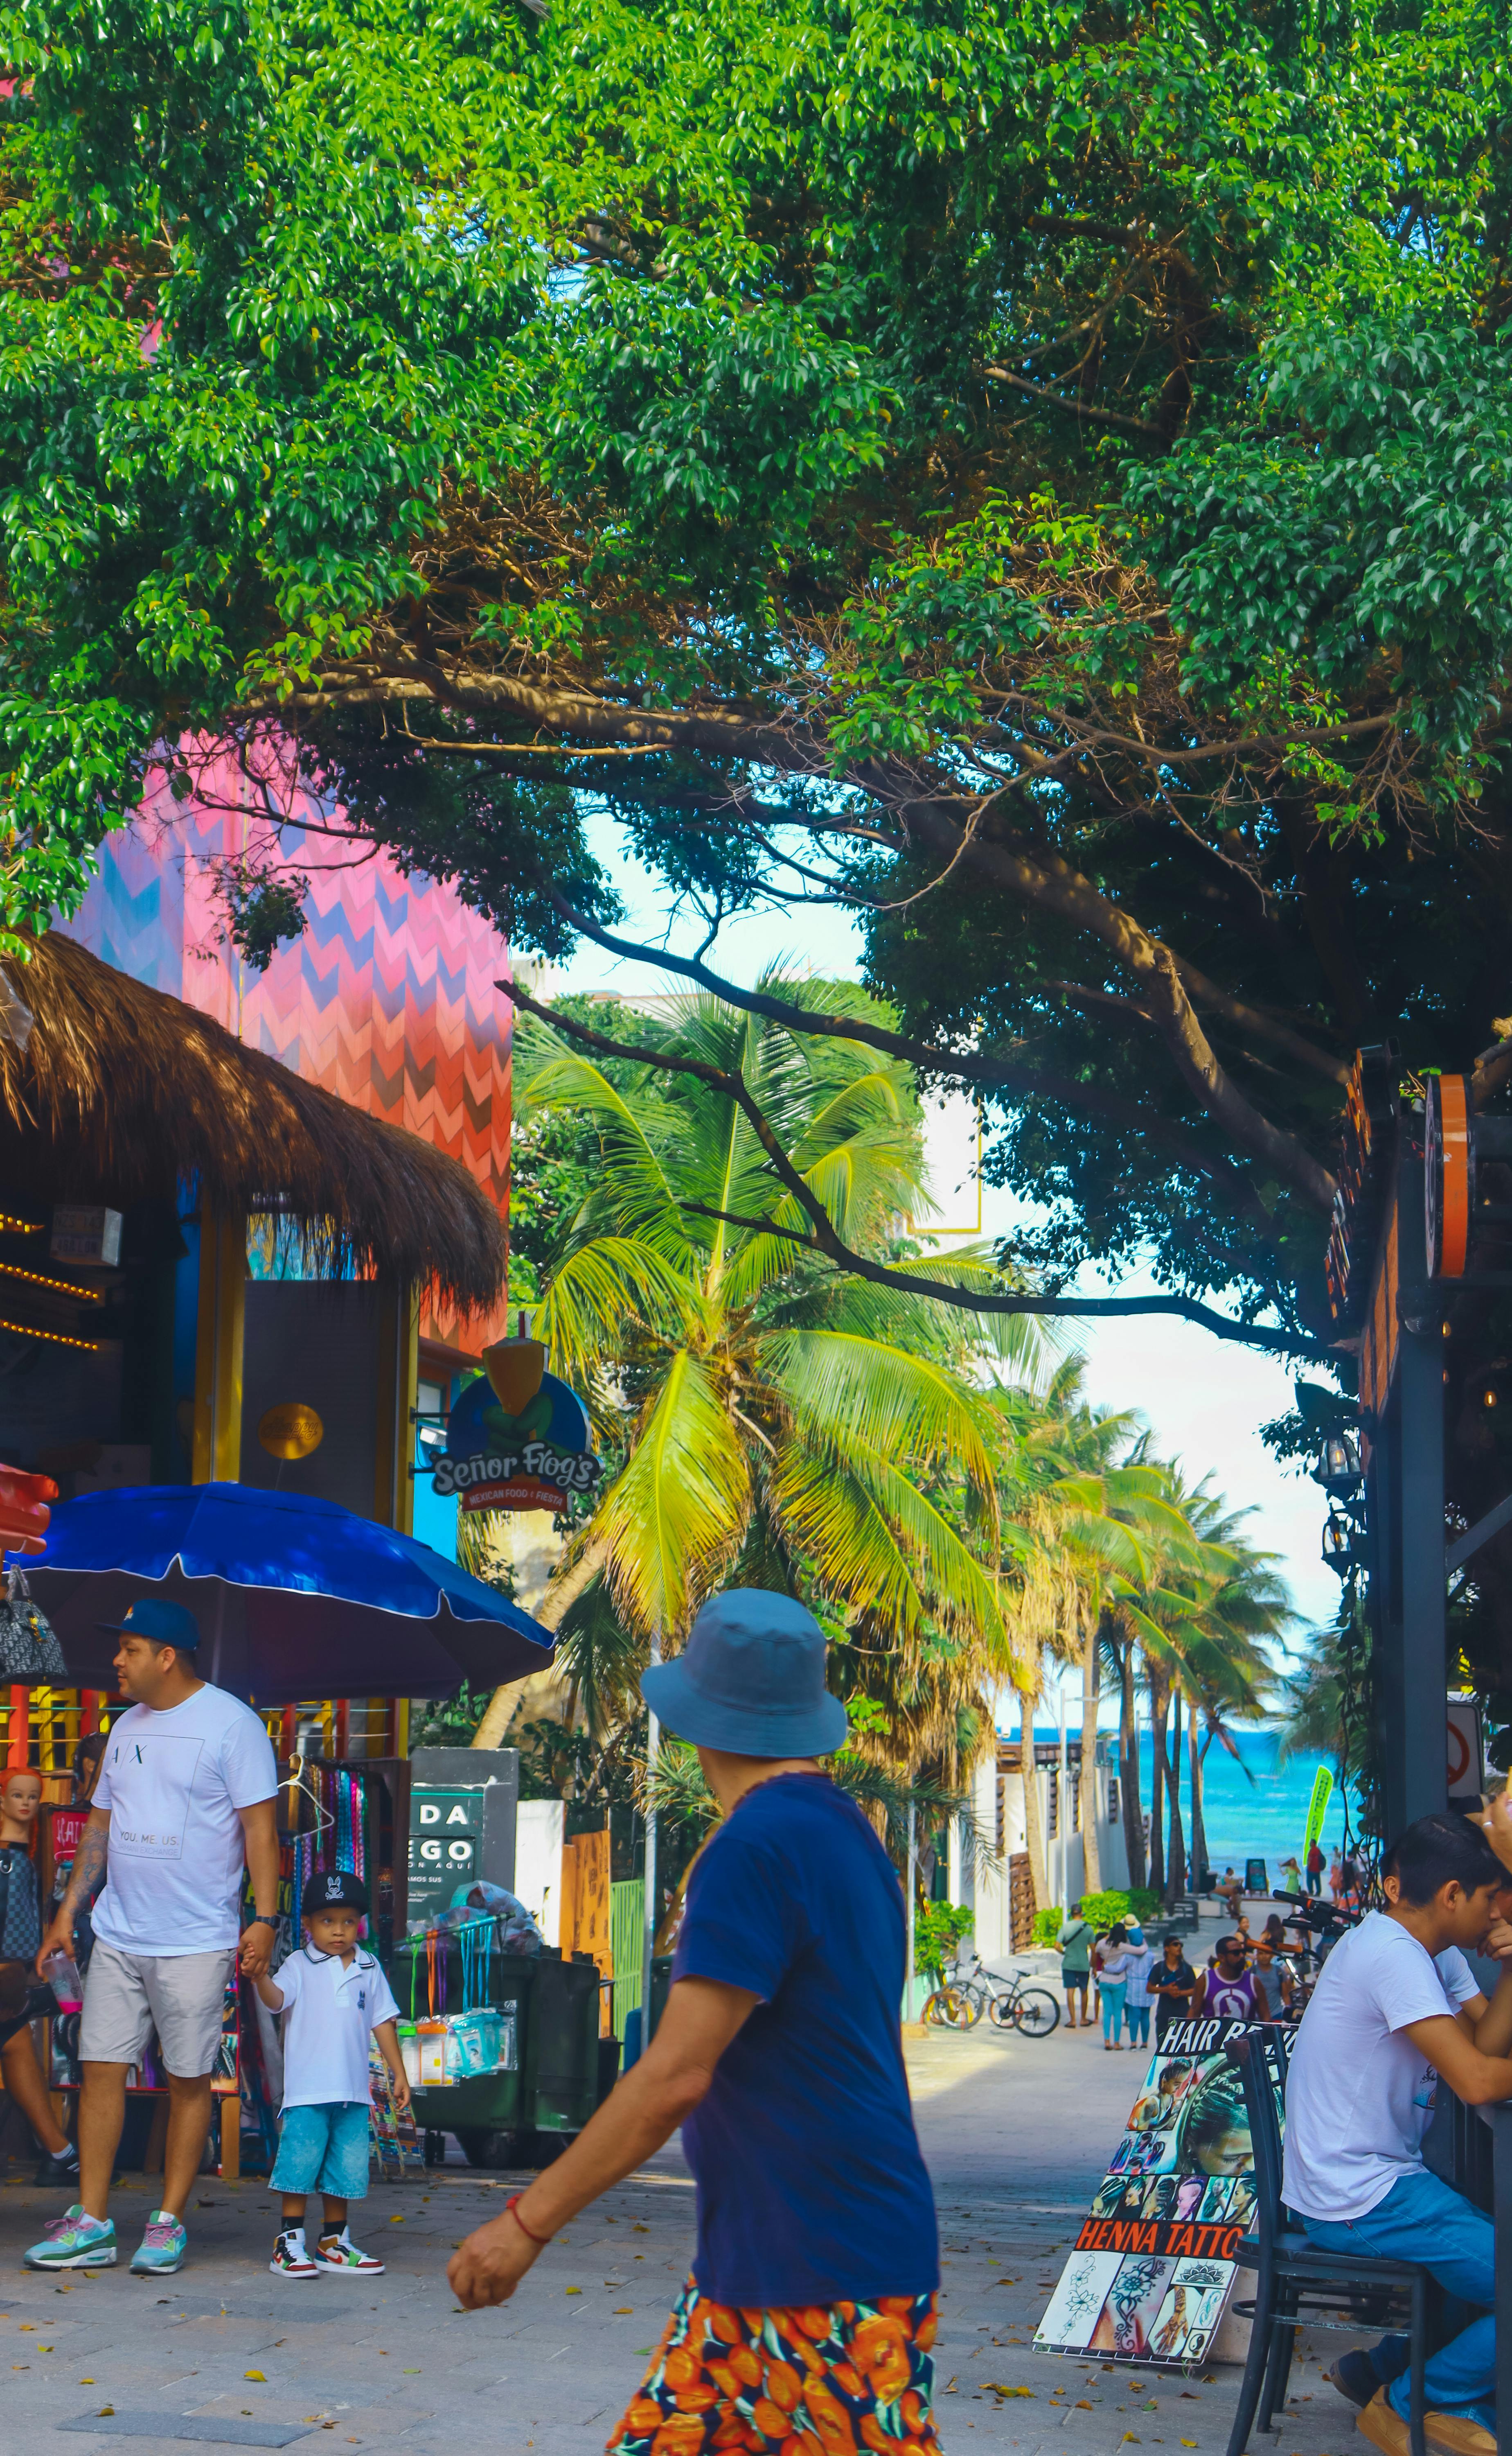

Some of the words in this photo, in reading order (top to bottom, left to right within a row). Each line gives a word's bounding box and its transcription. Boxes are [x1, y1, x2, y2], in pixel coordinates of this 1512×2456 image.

[435, 1454, 517, 1492] Señor
[523, 1442, 593, 1489] Frog's
[469, 1490, 504, 1505] MEXICAN
[505, 1489, 528, 1498] FOOD
[536, 1491, 563, 1506] FIESTA
[56, 1817, 86, 1847] HAI
[120, 1831, 137, 1842] YOU.
[141, 1834, 157, 1844] ME.
[162, 1836, 179, 1846] US.
[140, 1847, 178, 1856] EXCHANGE
[1159, 2020, 1221, 2053] HAIR
[1076, 2220, 1158, 2253] HENNA
